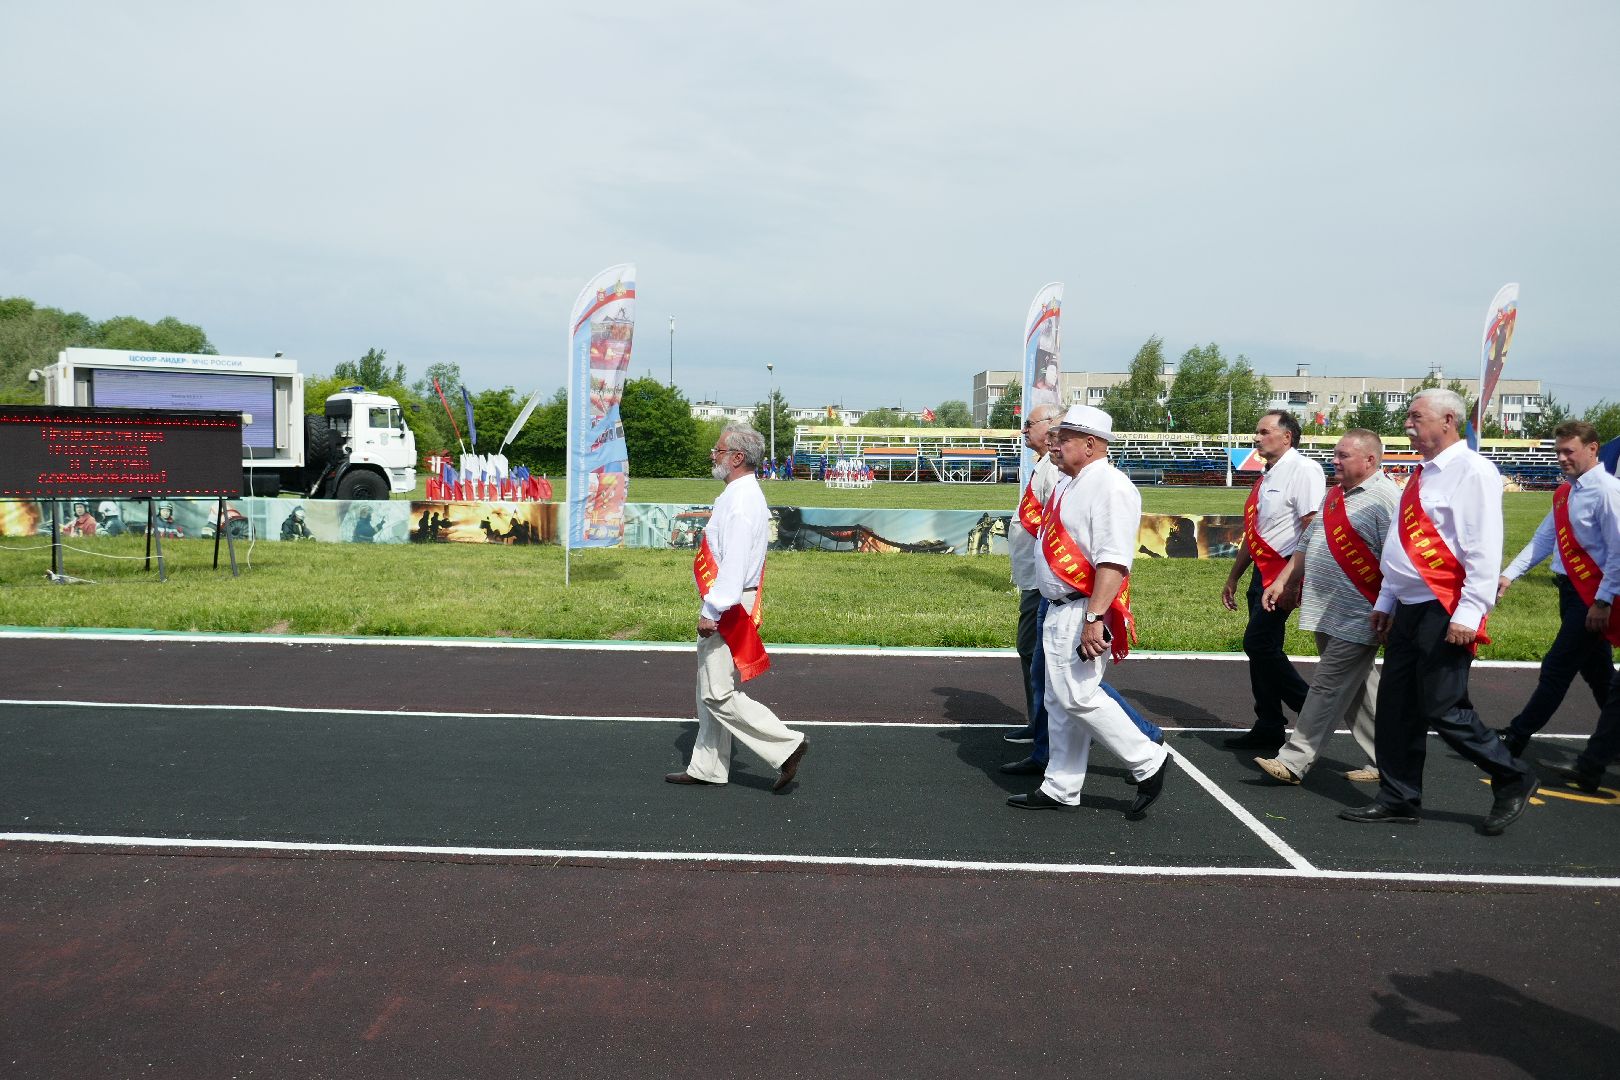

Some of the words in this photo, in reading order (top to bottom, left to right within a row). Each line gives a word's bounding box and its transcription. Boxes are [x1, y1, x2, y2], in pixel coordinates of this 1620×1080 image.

[129, 354, 157, 363] ЦСООР
[211, 360, 242, 368] РОССИИ
[1047, 521, 1087, 584] ВЕТЕРАН
[1333, 525, 1377, 584] ВЕТЕРАН
[1404, 504, 1445, 569] ВЕТЕРАН
[1558, 526, 1592, 581] ВЕТЕРАН
